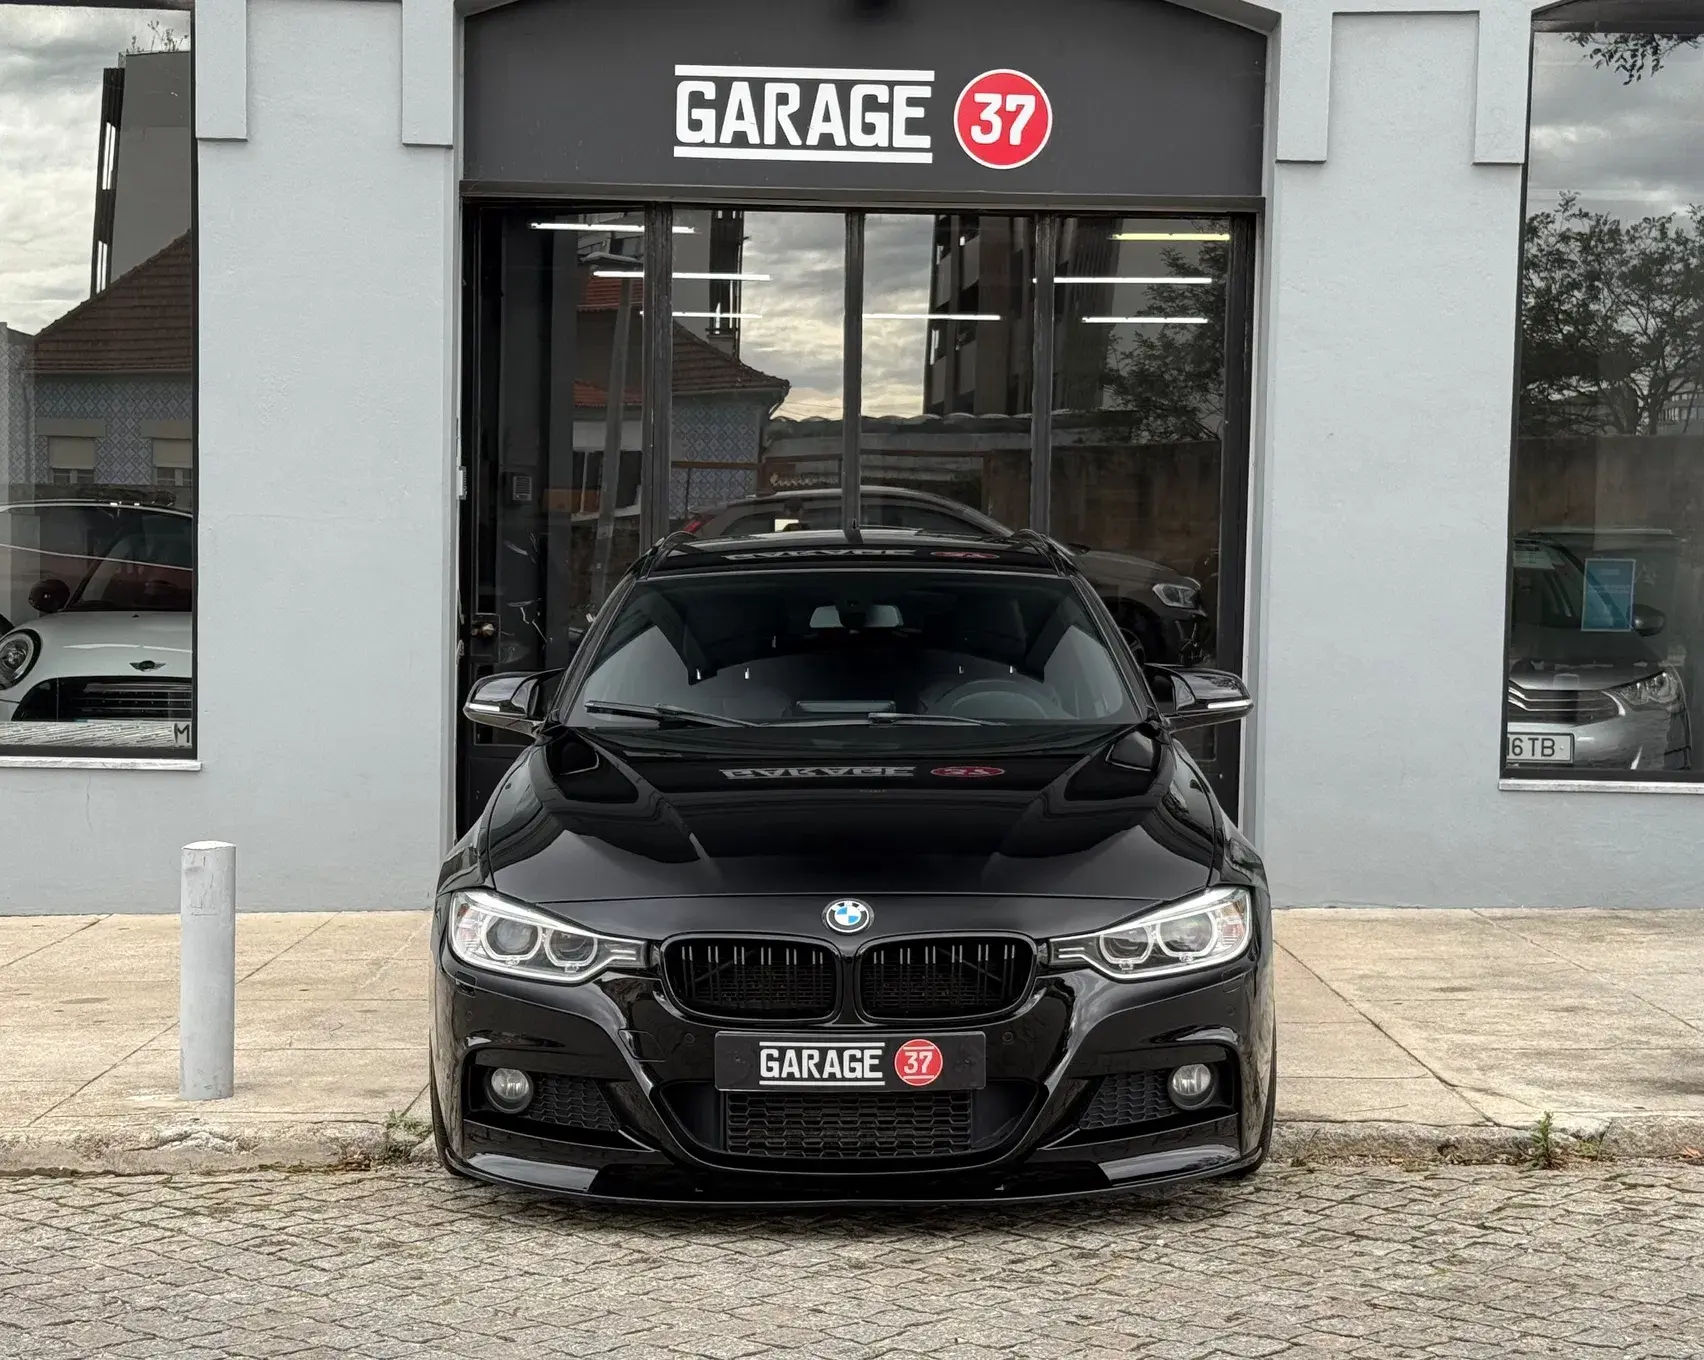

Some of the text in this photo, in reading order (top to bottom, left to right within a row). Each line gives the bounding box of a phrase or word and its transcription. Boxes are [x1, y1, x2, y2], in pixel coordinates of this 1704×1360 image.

[676, 80, 1036, 148] GARAGE 37
[759, 1049, 933, 1079] GARAGE 37
